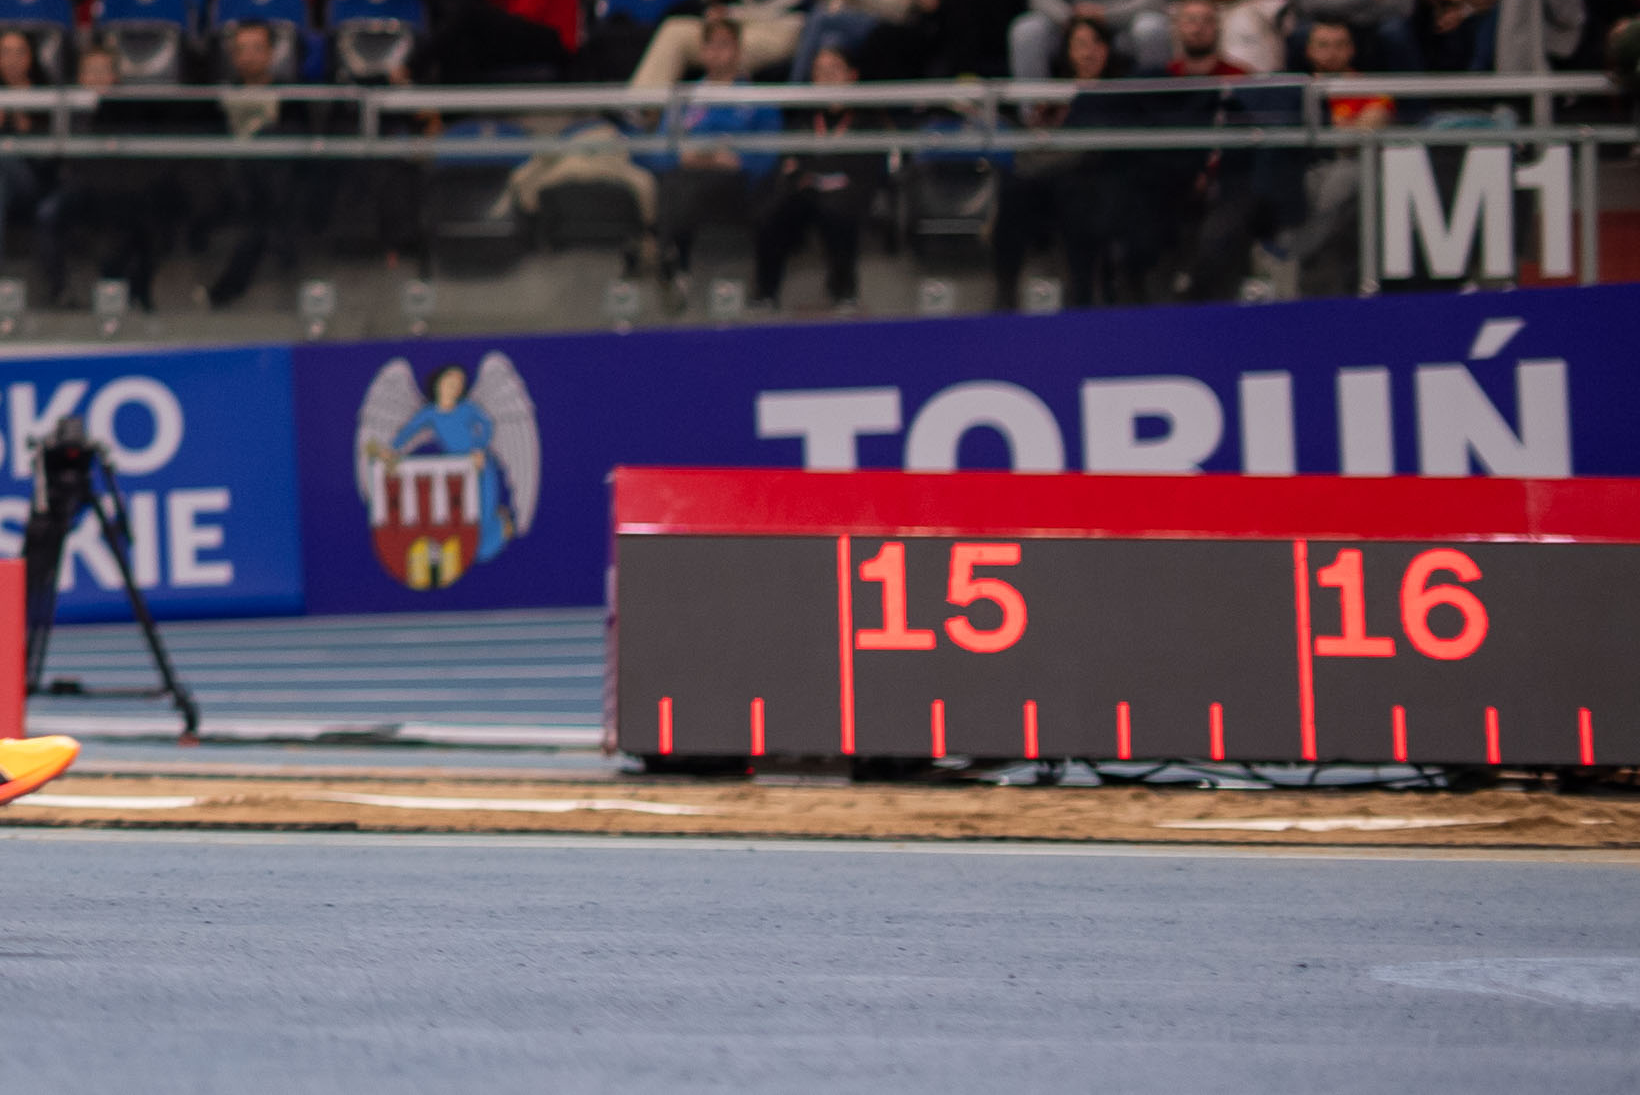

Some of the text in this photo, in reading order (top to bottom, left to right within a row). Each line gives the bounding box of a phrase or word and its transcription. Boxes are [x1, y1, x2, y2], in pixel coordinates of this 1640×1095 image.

[1382, 144, 1575, 281] M1
[855, 541, 1029, 655] 15
[1314, 547, 1491, 662] 16
